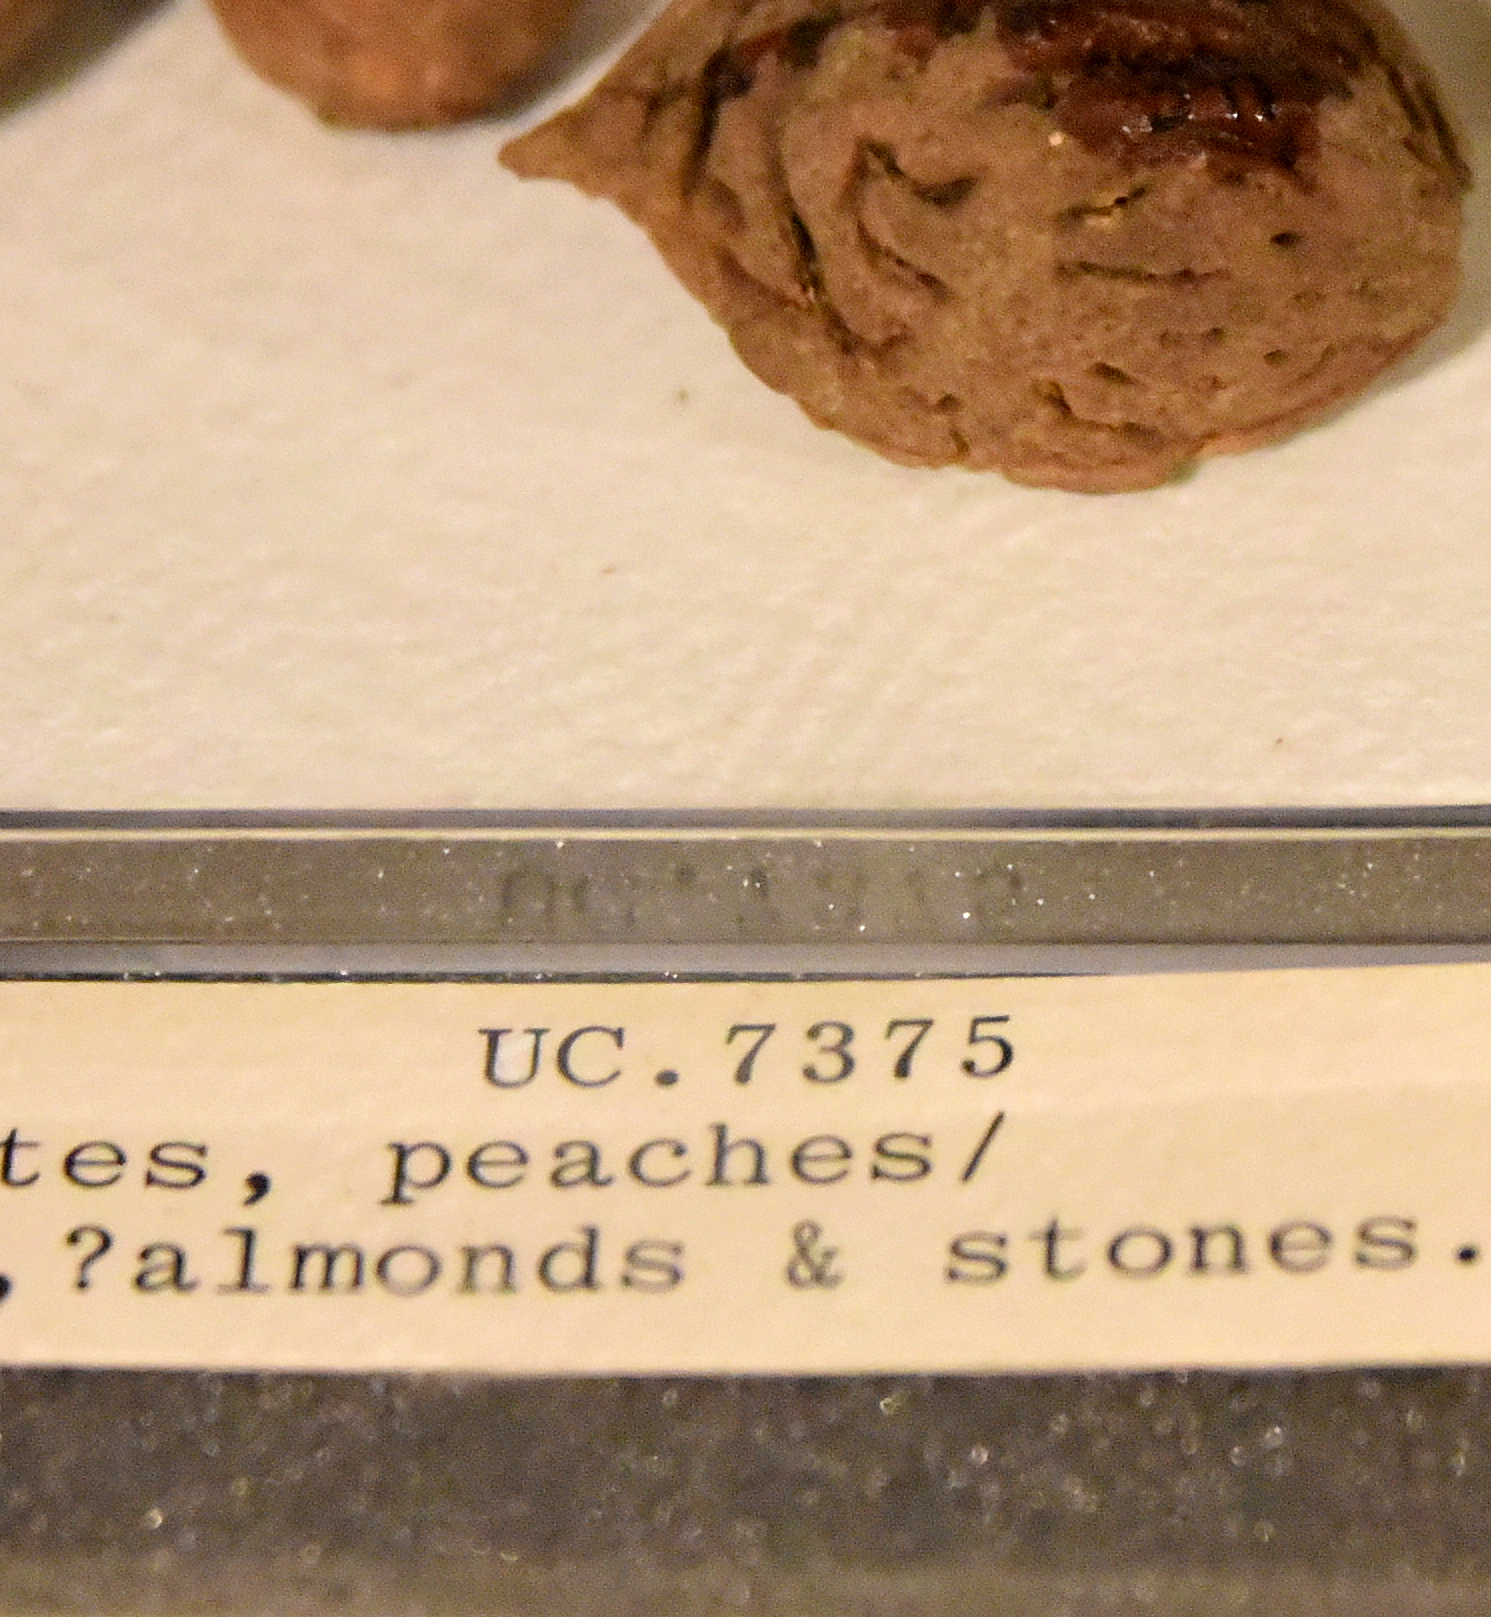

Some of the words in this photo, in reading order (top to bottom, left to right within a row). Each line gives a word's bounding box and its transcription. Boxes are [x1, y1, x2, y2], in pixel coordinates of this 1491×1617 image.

[477, 1014, 1015, 1091] UC.7375
[379, 1110, 1006, 1207] peaches/
[784, 1221, 842, 1290] &
[943, 1217, 1481, 1284] stones.
